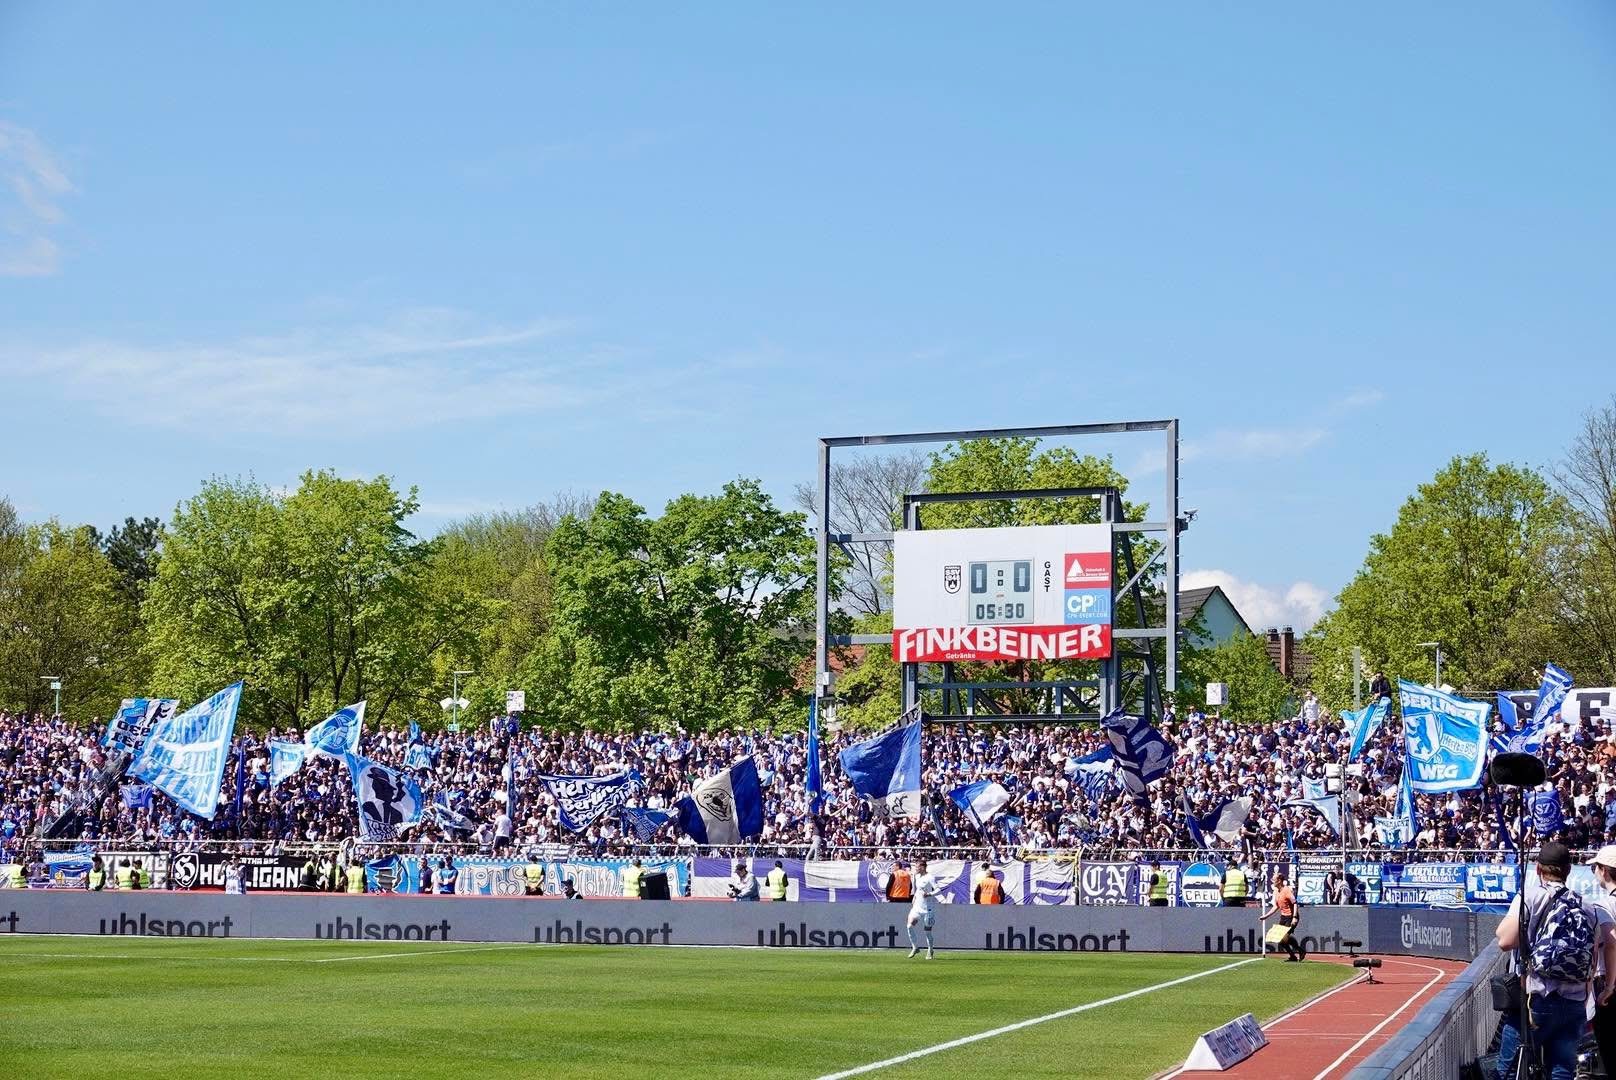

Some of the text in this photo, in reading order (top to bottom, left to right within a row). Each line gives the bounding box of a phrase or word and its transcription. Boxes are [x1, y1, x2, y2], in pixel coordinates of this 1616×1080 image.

[970, 563, 987, 593] 0
[1014, 562, 1030, 592] 0
[976, 603, 1024, 619] 05:30
[899, 624, 1104, 662] FINKBEINER
[945, 652, 976, 660] Getränke
[1418, 763, 1458, 779] WEG
[1349, 864, 1379, 876] SPREE
[1185, 890, 1219, 900] CREW
[99, 912, 234, 937] uhlsport
[315, 916, 451, 941] uhlsport
[534, 919, 673, 944] uhlsport
[757, 922, 899, 947] uhlsport
[1413, 919, 1452, 949] Husqvarna
[986, 926, 1131, 951] uhlsport
[1204, 928, 1343, 953] uhlsort
